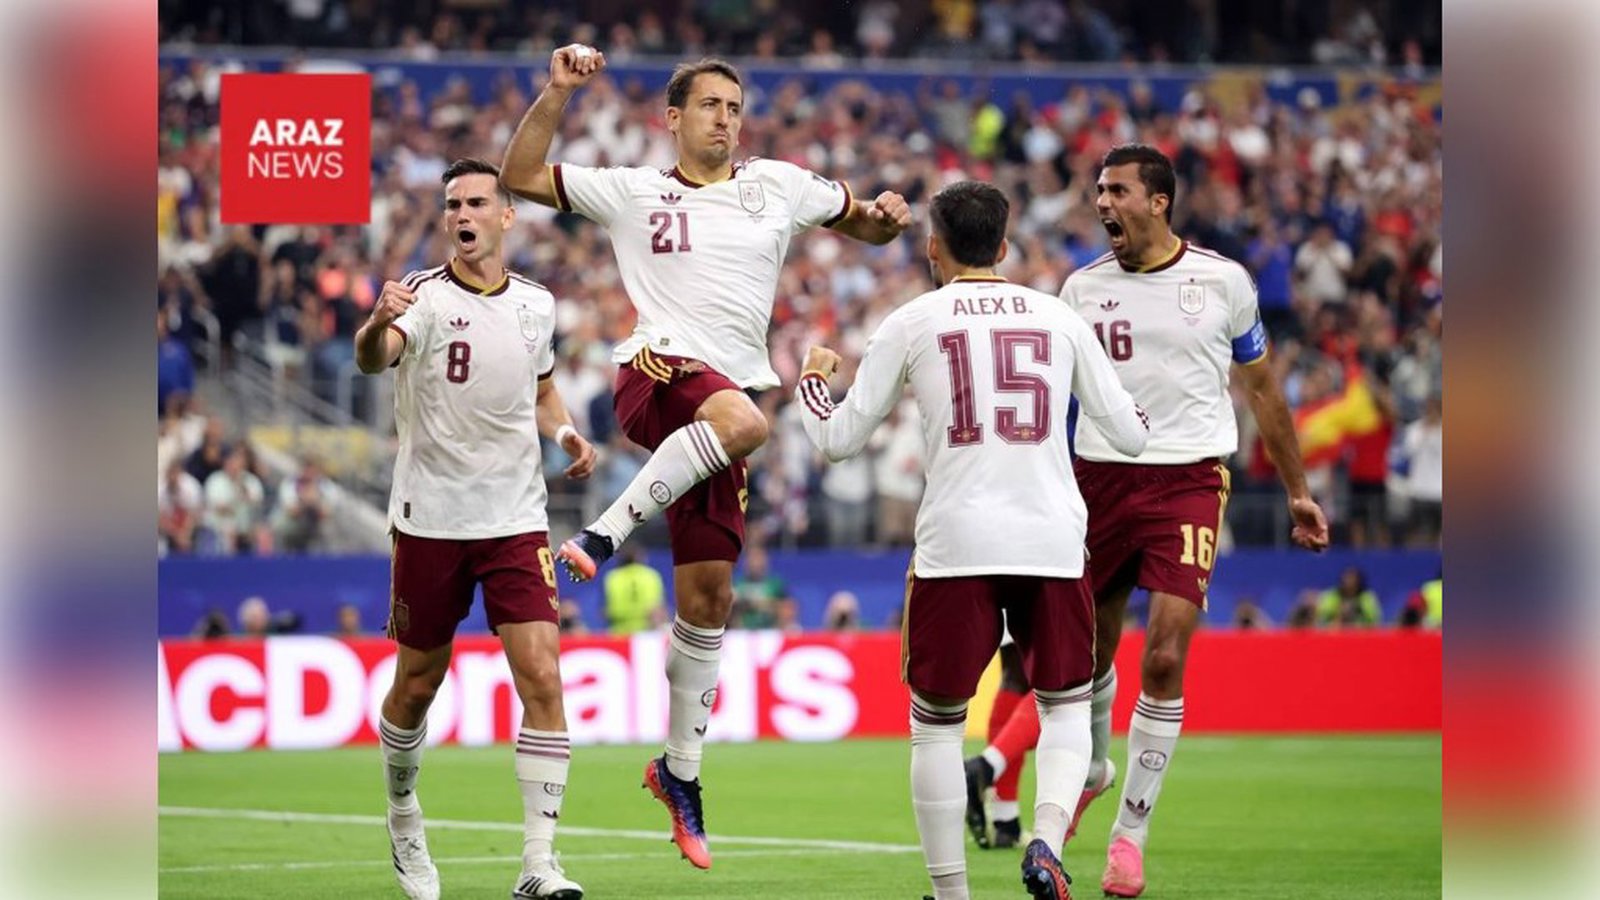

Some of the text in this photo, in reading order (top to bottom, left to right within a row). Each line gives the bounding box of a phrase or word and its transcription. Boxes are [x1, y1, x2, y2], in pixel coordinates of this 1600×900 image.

[649, 211, 692, 254] 21
[953, 296, 1033, 316] ALEX B.
[1093, 319, 1133, 362] 16
[446, 341, 471, 384] 8
[937, 328, 1052, 448] 15
[537, 547, 557, 588] 8
[1180, 523, 1215, 571] 16
[158, 631, 859, 753] cDonald's
